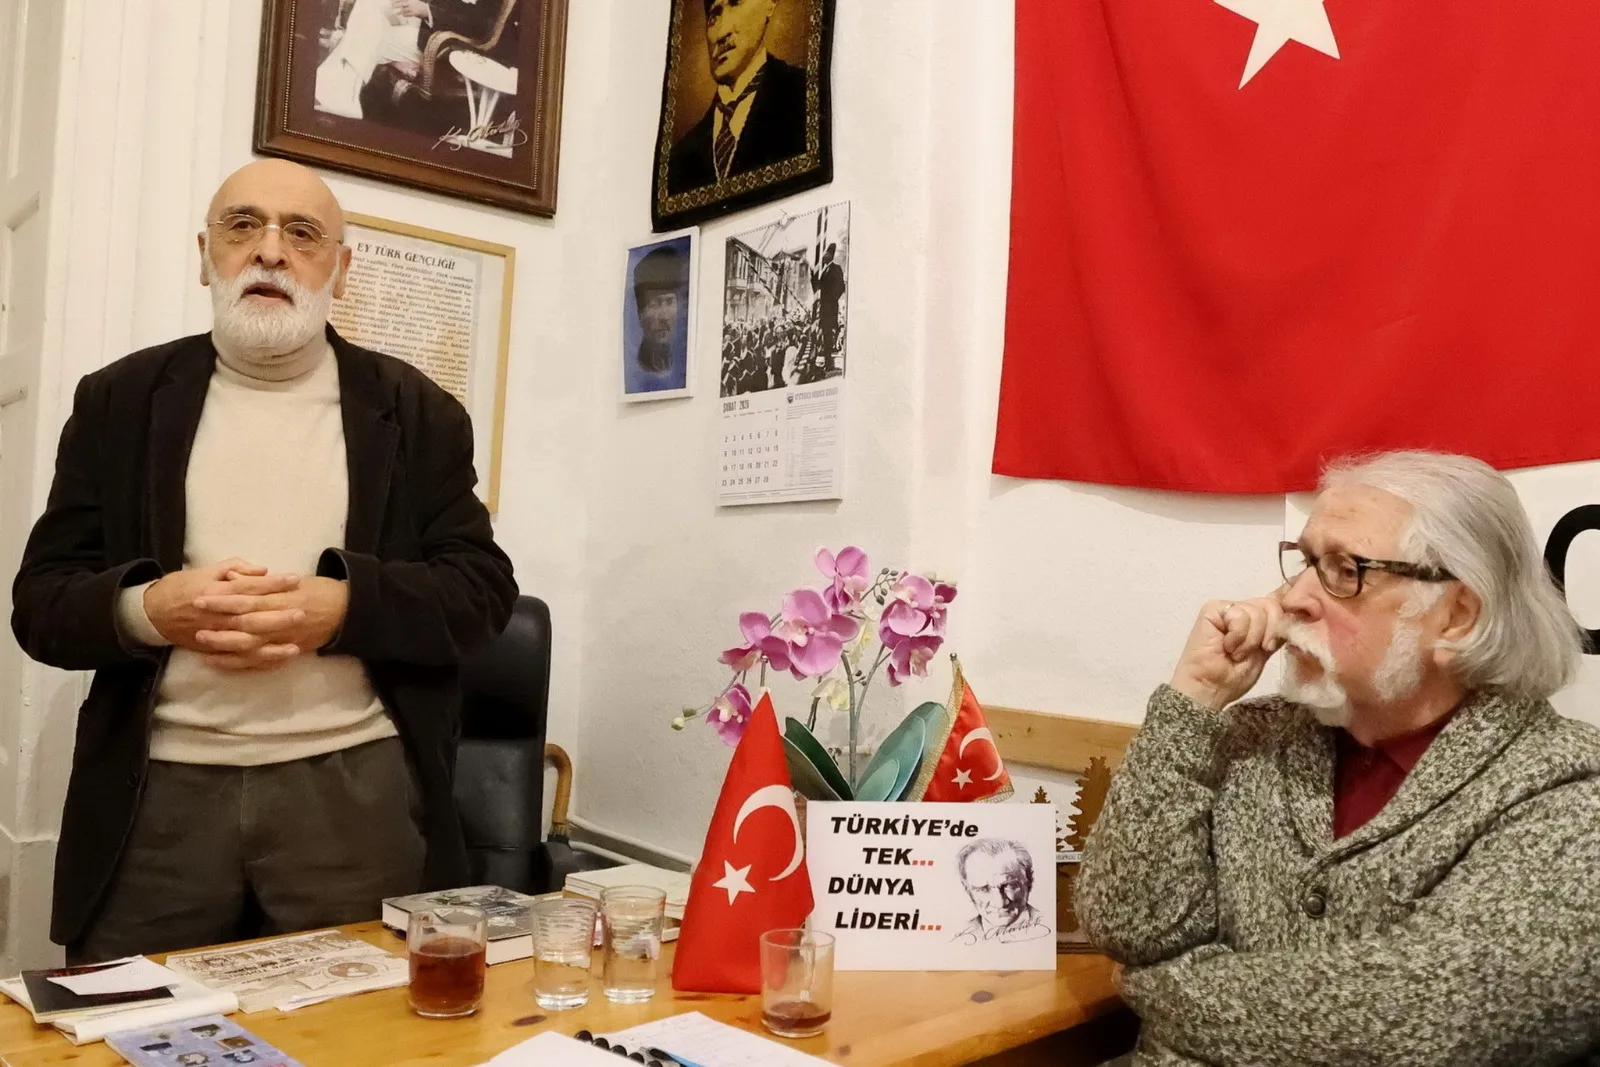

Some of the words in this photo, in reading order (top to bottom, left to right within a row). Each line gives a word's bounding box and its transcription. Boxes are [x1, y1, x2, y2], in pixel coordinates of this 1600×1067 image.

[357, 242, 372, 253] EY
[374, 245, 401, 260] TÜRK
[404, 252, 456, 271] GENÇLİĞİ!
[862, 847, 934, 866] TEK...
[828, 874, 915, 896] DÜNYA
[835, 908, 942, 931] LİDERİ...
